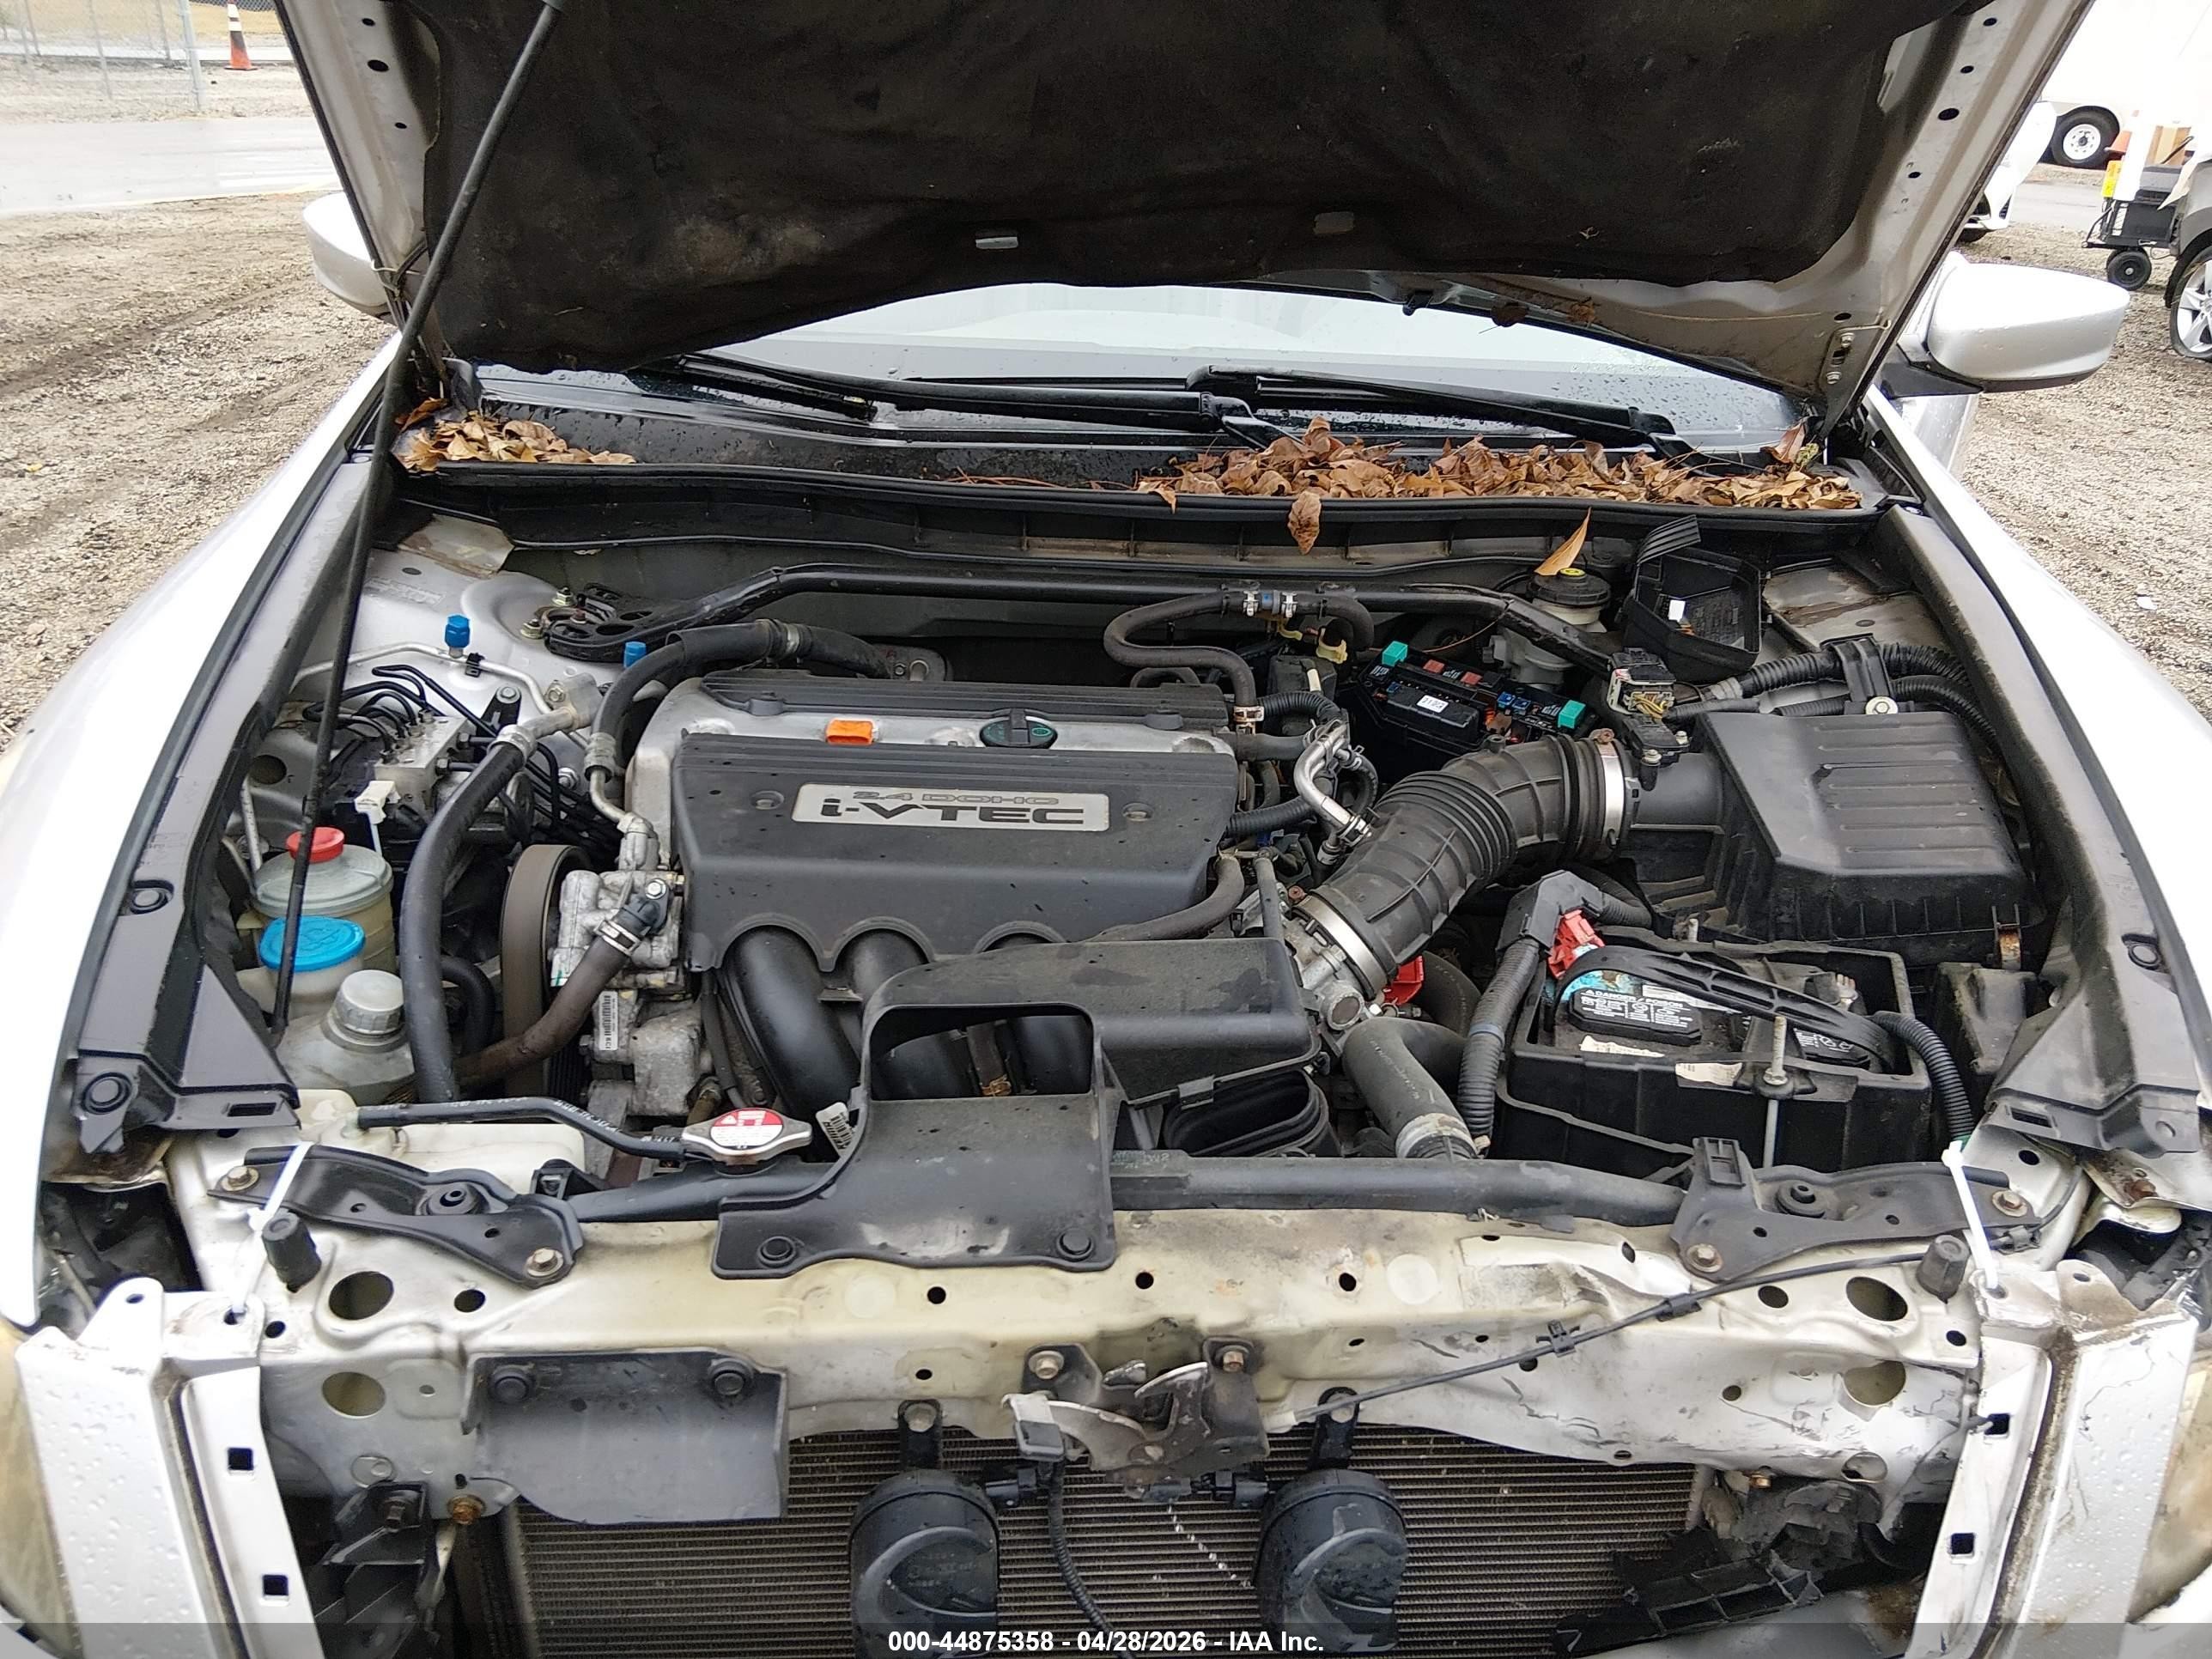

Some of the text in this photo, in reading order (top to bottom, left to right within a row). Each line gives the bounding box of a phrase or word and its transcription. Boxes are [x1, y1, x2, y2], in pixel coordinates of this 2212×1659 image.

[852, 791, 914, 802] 2.4
[820, 798, 1085, 825] i-VTEC
[1595, 990, 1637, 1002] DANGER
